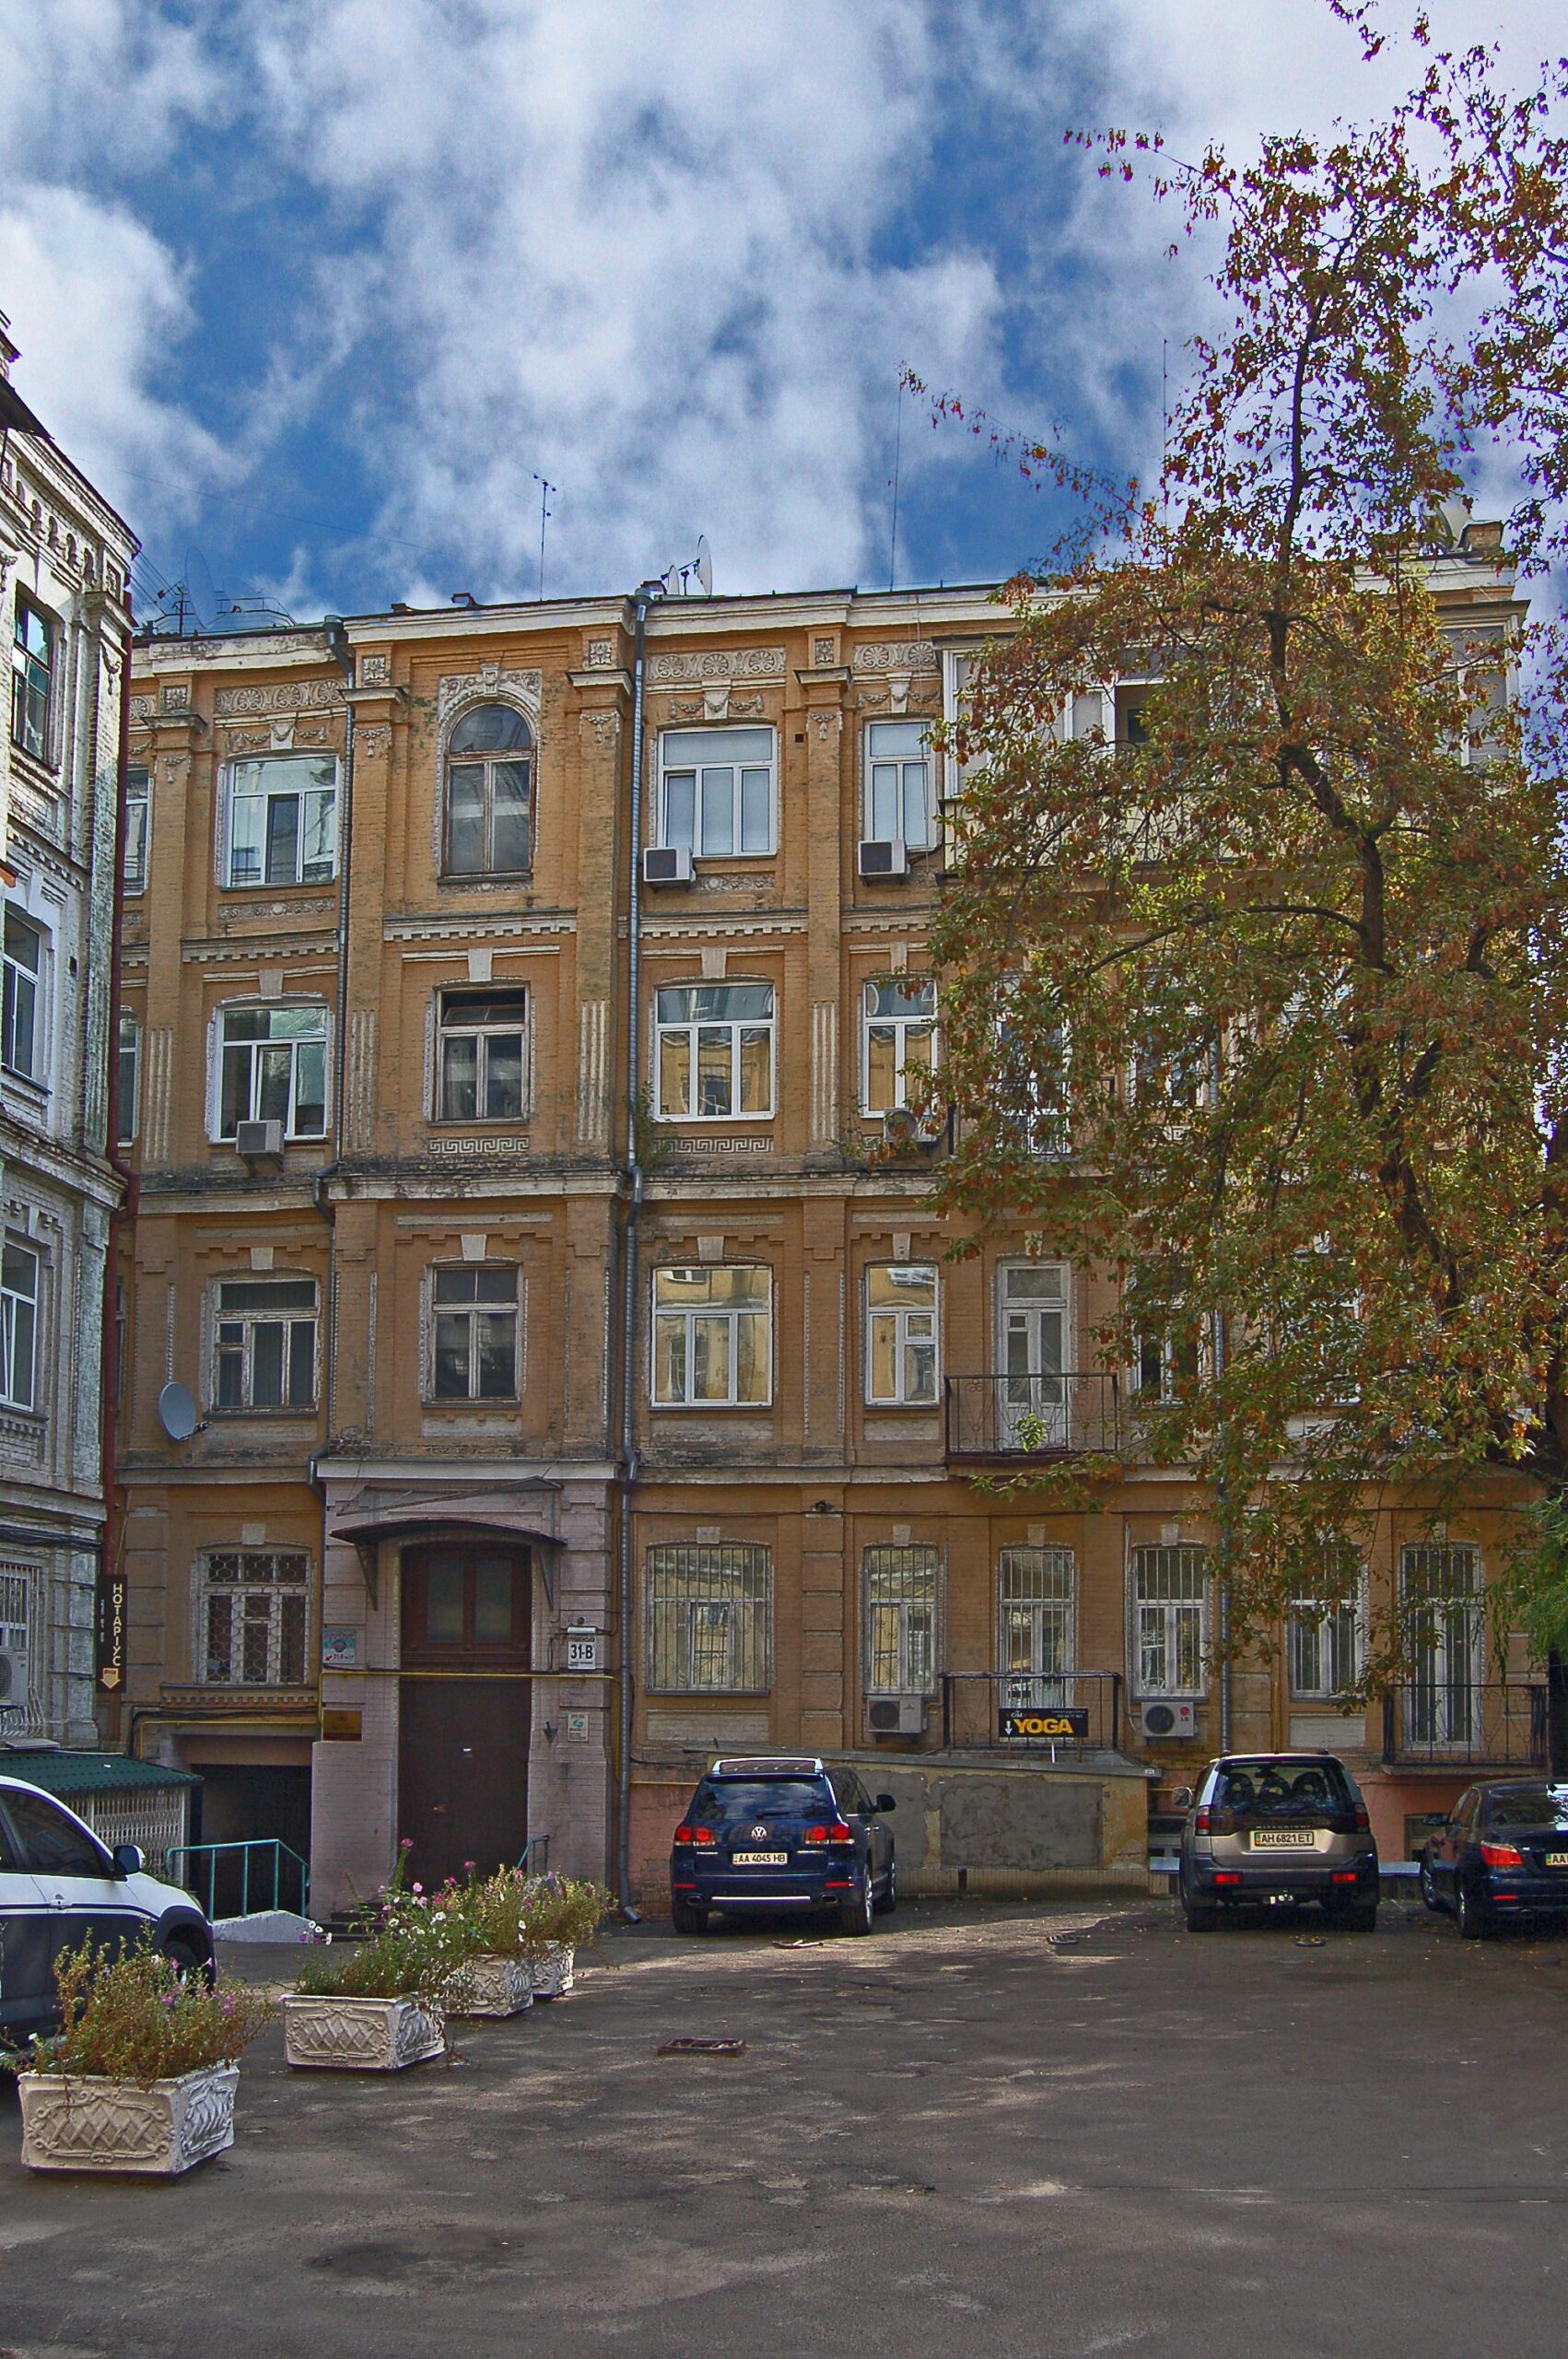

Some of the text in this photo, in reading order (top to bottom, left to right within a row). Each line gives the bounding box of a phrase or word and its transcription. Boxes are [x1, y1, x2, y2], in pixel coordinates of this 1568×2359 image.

[112, 1583, 123, 1667] НОТАРІУС
[1013, 1718, 1074, 1734] YOGA
[1261, 1834, 1311, 1843] AH 6821 ET
[738, 1854, 750, 1862] AA
[752, 1854, 771, 1862] 4045
